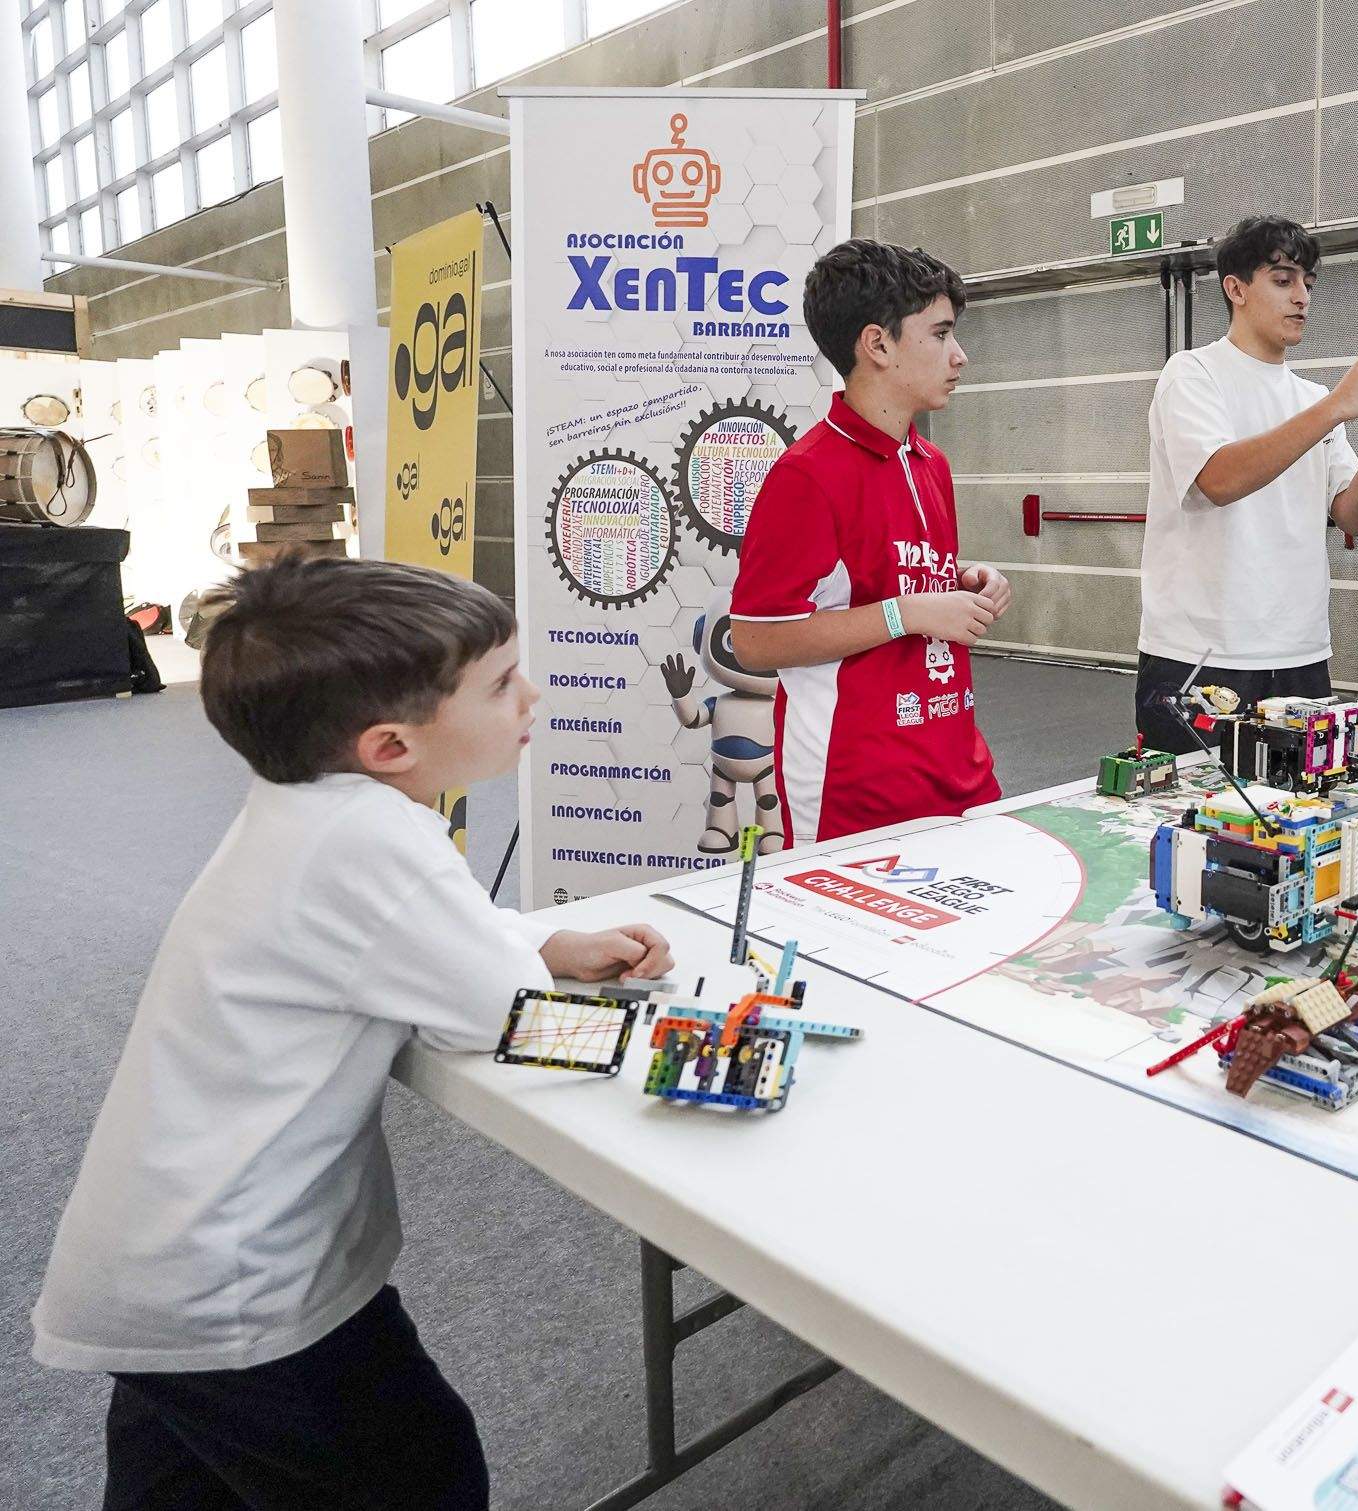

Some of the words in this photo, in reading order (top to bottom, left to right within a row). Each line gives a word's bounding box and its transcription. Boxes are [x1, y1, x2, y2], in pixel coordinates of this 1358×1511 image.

[567, 231, 684, 250] ASOCIACIÓN
[693, 322, 790, 338] BARBANZA
[395, 251, 475, 430] .gal
[567, 349, 602, 359] asociación
[604, 350, 616, 359] ten
[617, 351, 636, 359] como
[637, 351, 656, 360] meta
[657, 351, 702, 361] fundamental
[703, 351, 739, 361] contribuir
[741, 353, 750, 361] ao
[751, 353, 814, 362] desenvolvemento
[597, 363, 617, 372] social
[624, 364, 663, 373] profesional
[665, 365, 673, 373] da
[709, 366, 719, 374] na
[720, 366, 753, 374] contorna
[590, 414, 603, 422] un
[606, 403, 639, 418] espazo
[549, 438, 564, 448] sen
[567, 423, 611, 441] barreiras
[614, 417, 631, 428] nin
[718, 421, 764, 433] INNOVACIÓN
[703, 433, 765, 445] PROXECTOS
[692, 446, 730, 457] CULTURA
[731, 446, 783, 460] TECNOLÓXIC
[397, 452, 420, 500] .gal
[590, 464, 614, 475] STEM
[564, 486, 640, 500] PROGRAMACIÓN
[734, 481, 745, 535] EMPREGO
[431, 482, 468, 555] .gal
[640, 514, 650, 527] DE
[650, 486, 660, 570] VOLUNTARIADO
[660, 506, 669, 549] EQUIPO
[583, 539, 592, 589] INTELIXENCIA
[592, 538, 602, 593] ARTIFICIAL
[549, 629, 639, 646] TECNOLOXÍA
[550, 672, 626, 690] ROBÓTICA
[898, 705, 920, 714] FIRST
[550, 718, 622, 734] ENXEÑERÍA
[551, 763, 672, 781] PROGRAMACIÓN
[551, 804, 642, 823] INNOVACIÓN
[552, 848, 642, 866] INTELIXENCIA
[928, 881, 985, 901] LEGO
[950, 876, 1014, 896] FIRST
[804, 875, 940, 924] CHALLENGE
[906, 887, 989, 916] LEAGUE
